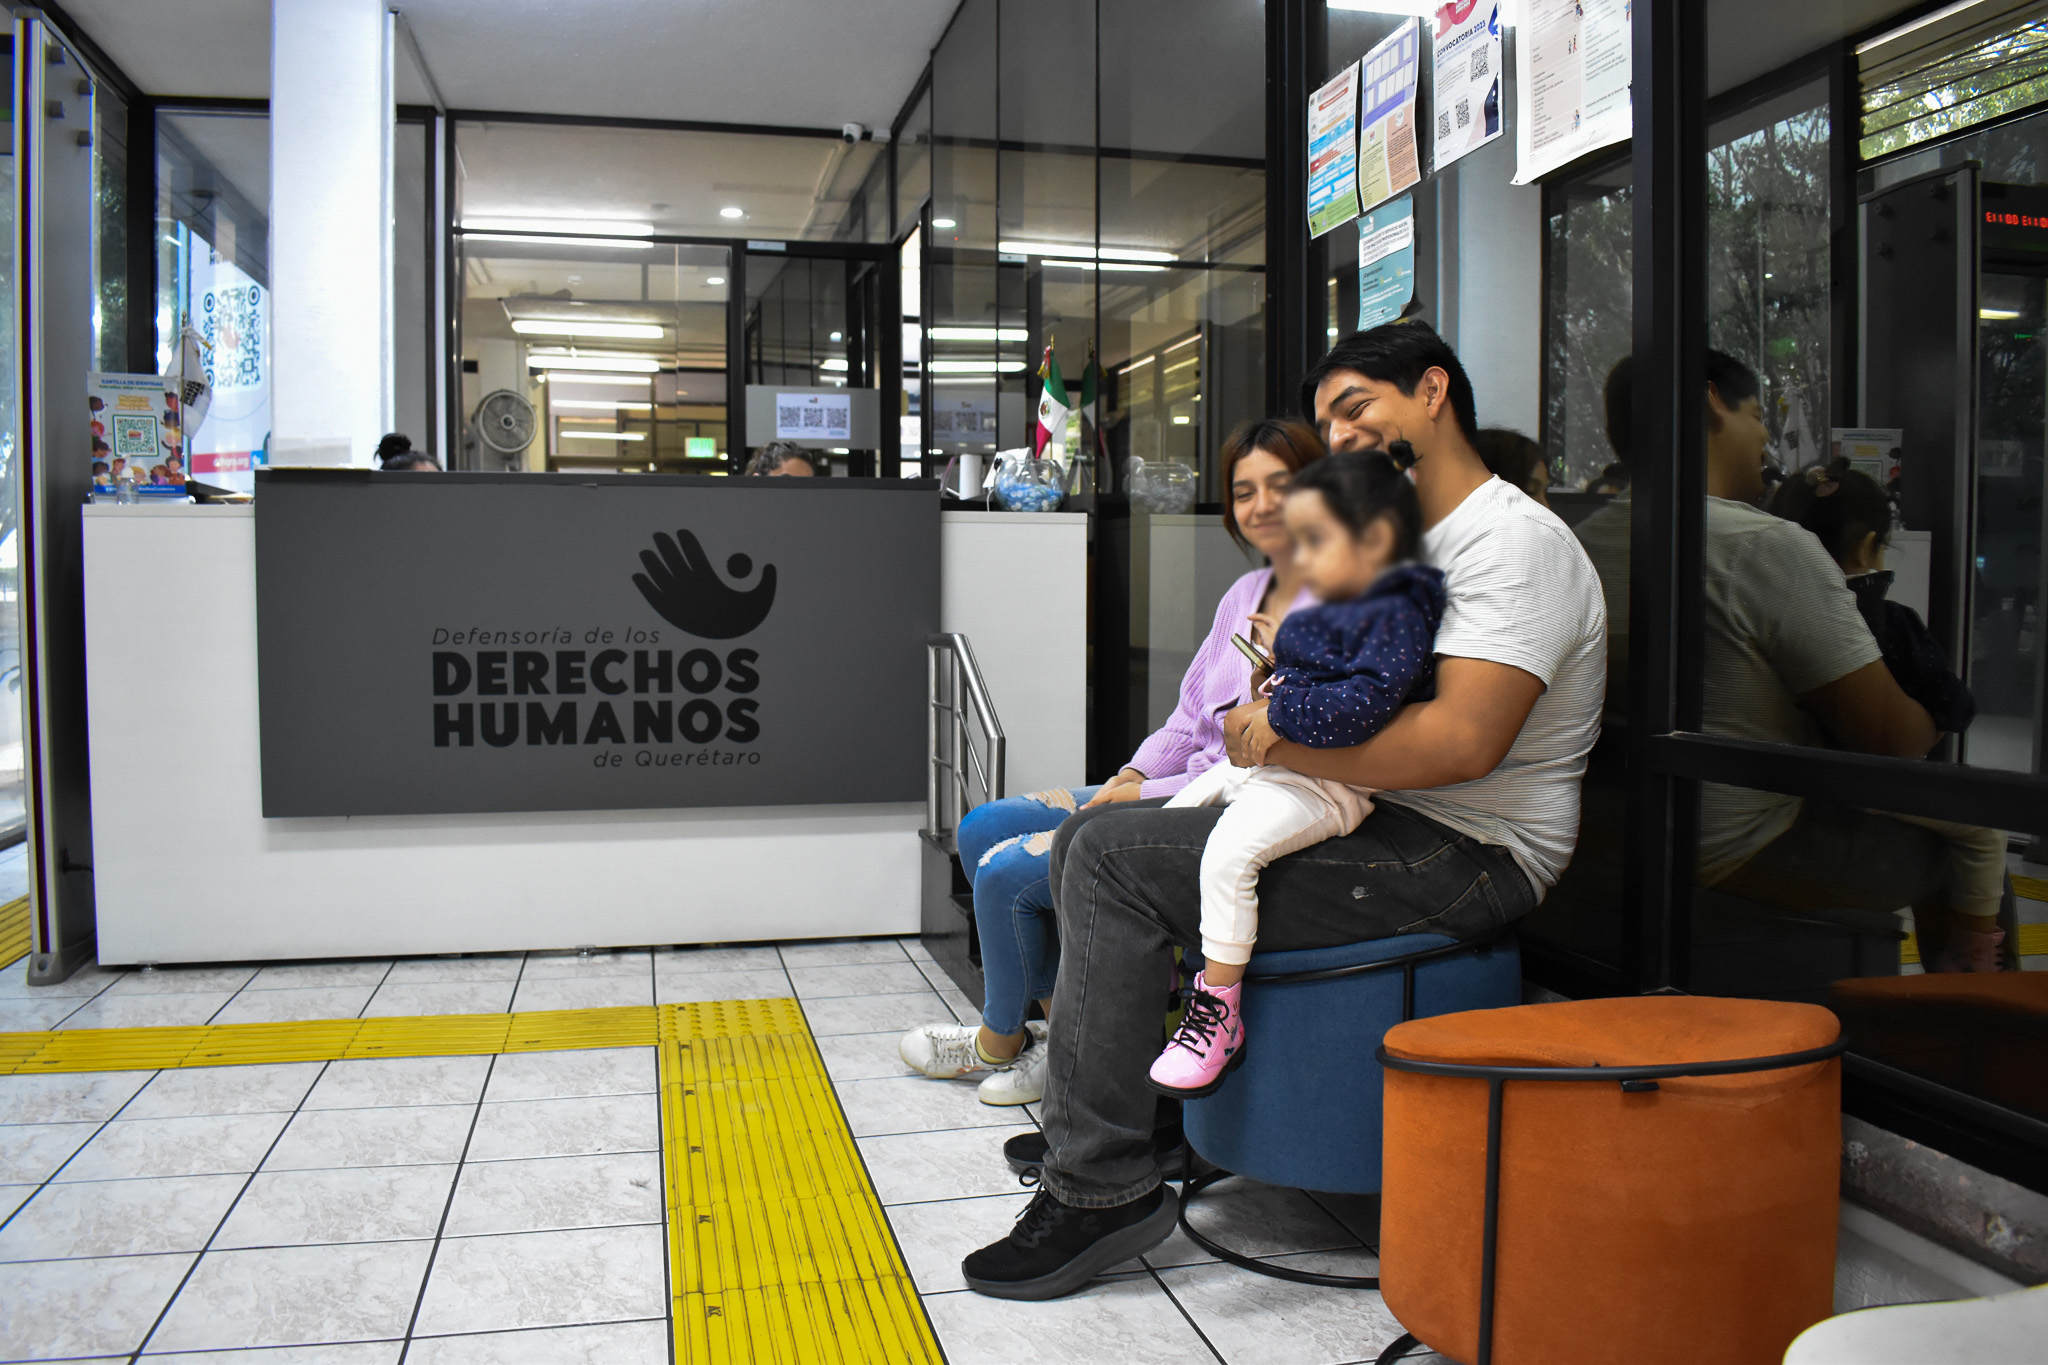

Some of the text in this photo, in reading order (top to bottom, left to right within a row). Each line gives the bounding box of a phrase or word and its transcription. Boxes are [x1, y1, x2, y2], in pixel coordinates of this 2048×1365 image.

[1437, 28, 1473, 57] CONVOCATORIA
[432, 626, 661, 645] Defensoría de los
[432, 647, 761, 696] DERECHOS
[432, 697, 761, 748] HUMANOS
[593, 747, 761, 769] de Querétaro
